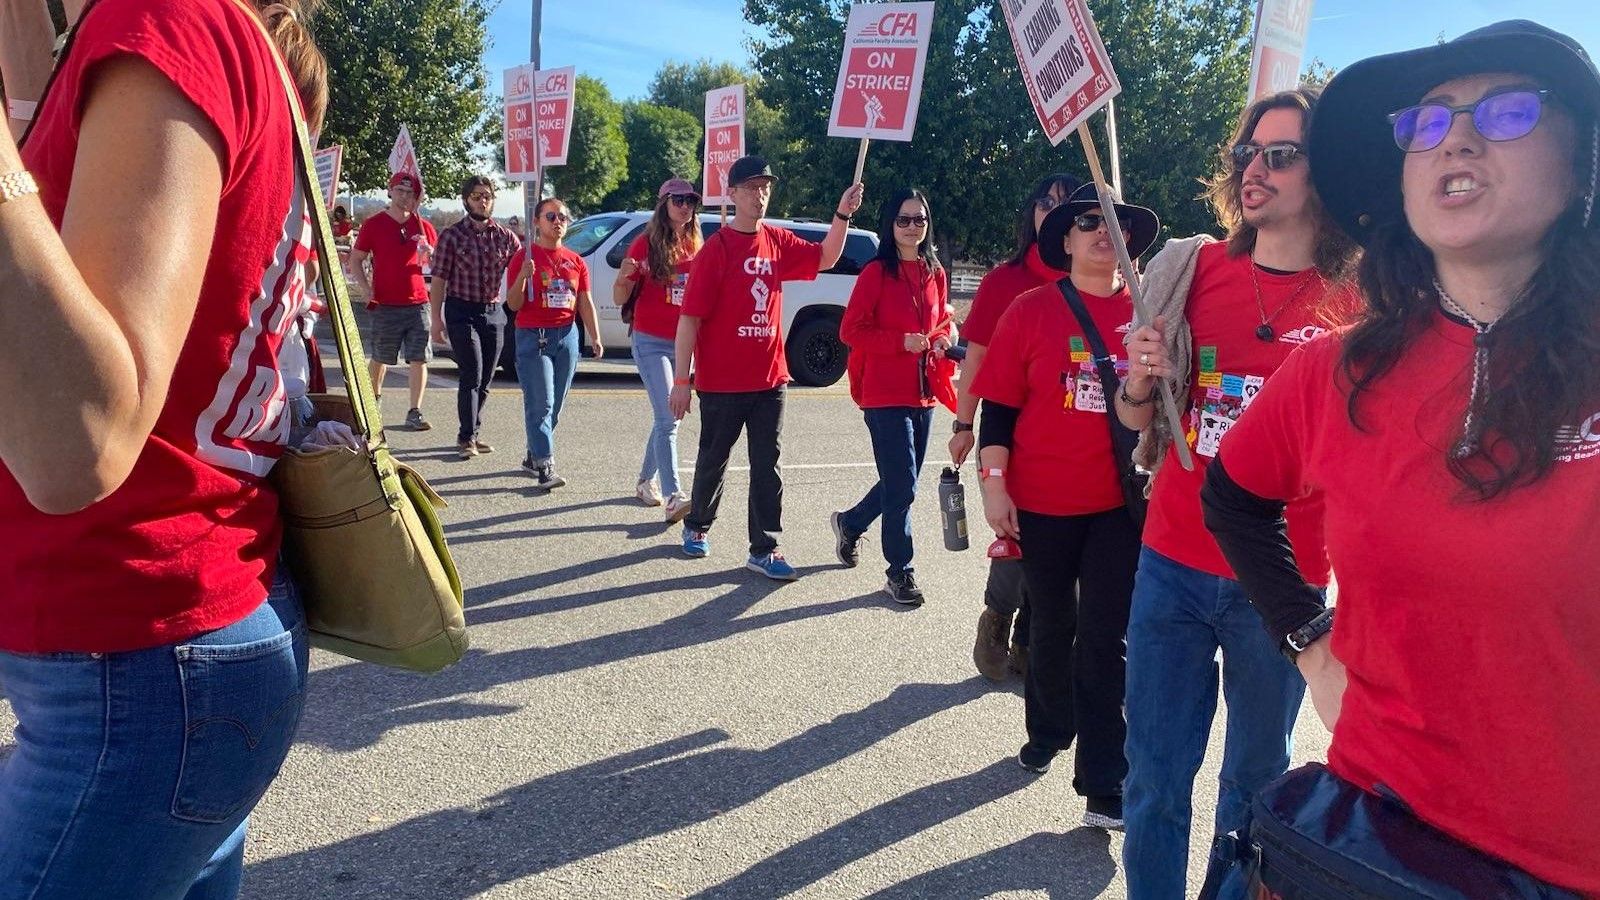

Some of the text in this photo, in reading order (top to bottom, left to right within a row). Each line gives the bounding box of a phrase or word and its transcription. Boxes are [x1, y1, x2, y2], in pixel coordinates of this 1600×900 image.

[878, 13, 918, 36] CFA
[1023, 0, 1061, 57] LEARNING
[867, 51, 896, 69] ON
[1036, 34, 1084, 103] CONDITIONS
[545, 74, 568, 92] CFA
[846, 73, 910, 91] STRIKE!
[515, 106, 527, 122] ON
[539, 102, 556, 115] ON
[720, 94, 738, 117] CFA
[538, 118, 565, 130] RIKE!
[716, 131, 731, 145] ON
[708, 148, 739, 163] STRIKE!
[743, 256, 773, 275] CFA
[751, 313, 769, 324] ON
[737, 325, 777, 337] STRIKE
